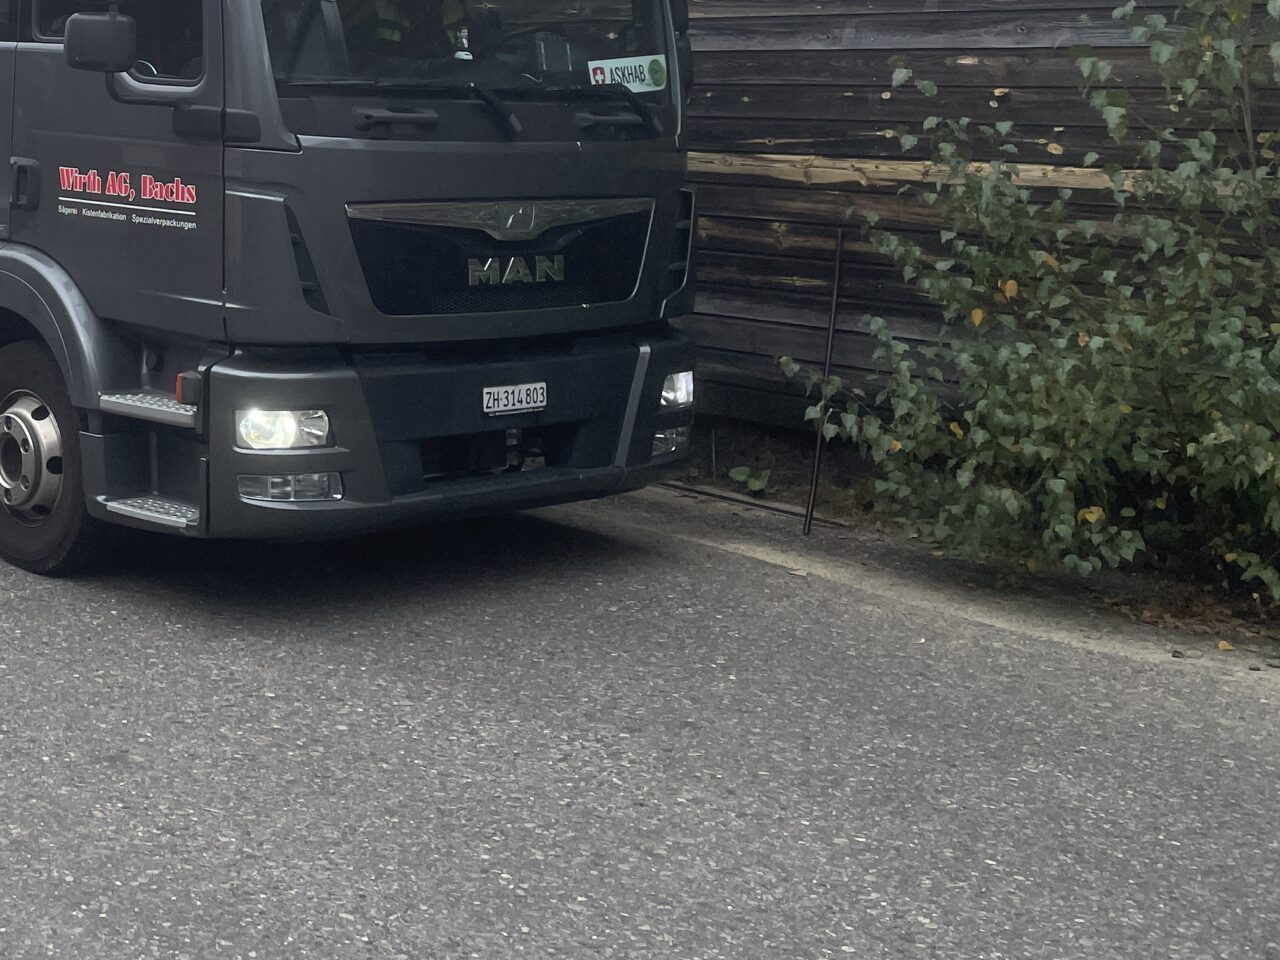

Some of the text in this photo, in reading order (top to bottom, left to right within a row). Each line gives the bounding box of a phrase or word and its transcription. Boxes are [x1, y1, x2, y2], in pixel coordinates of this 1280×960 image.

[609, 64, 646, 84] ASKHAB
[59, 166, 197, 204] Wirth AG, Bachs
[82, 207, 127, 221] Kistenfabrikation
[131, 213, 197, 230] Spezialverpackungen
[467, 255, 565, 287] MAN
